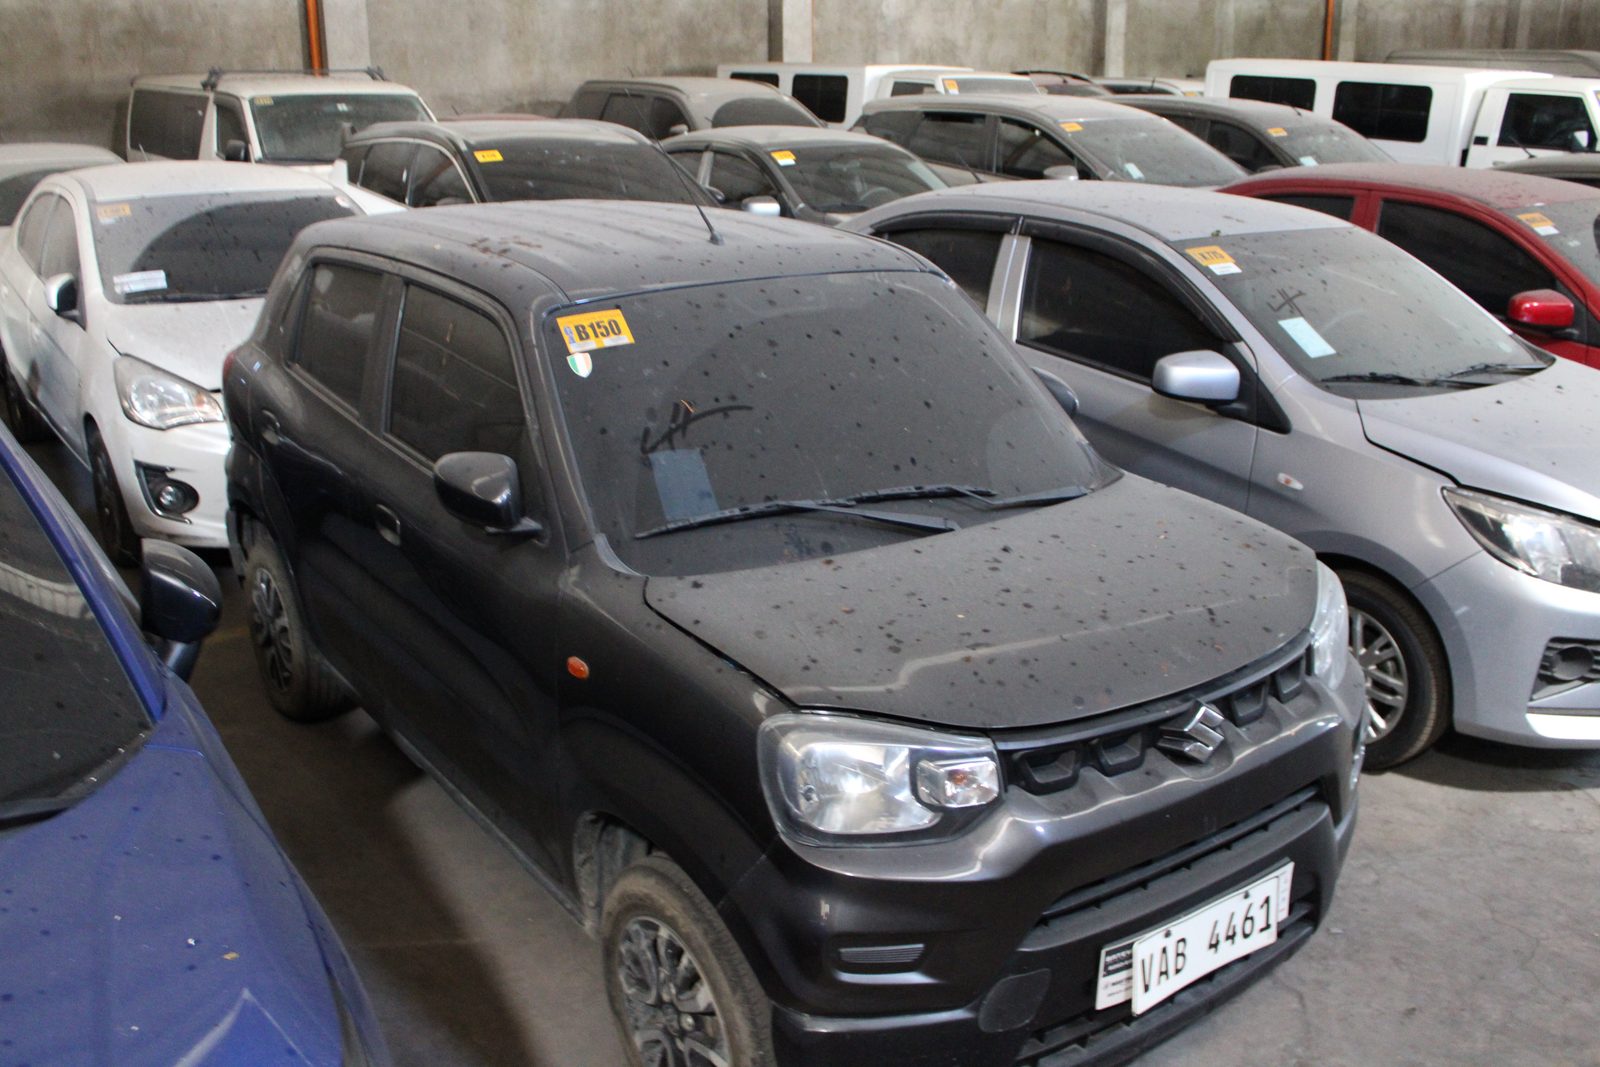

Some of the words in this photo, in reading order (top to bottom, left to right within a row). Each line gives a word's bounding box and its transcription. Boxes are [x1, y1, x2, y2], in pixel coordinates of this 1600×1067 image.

[574, 319, 622, 341] B150
[1141, 937, 1187, 994] VAB
[1208, 895, 1271, 954] 4461
